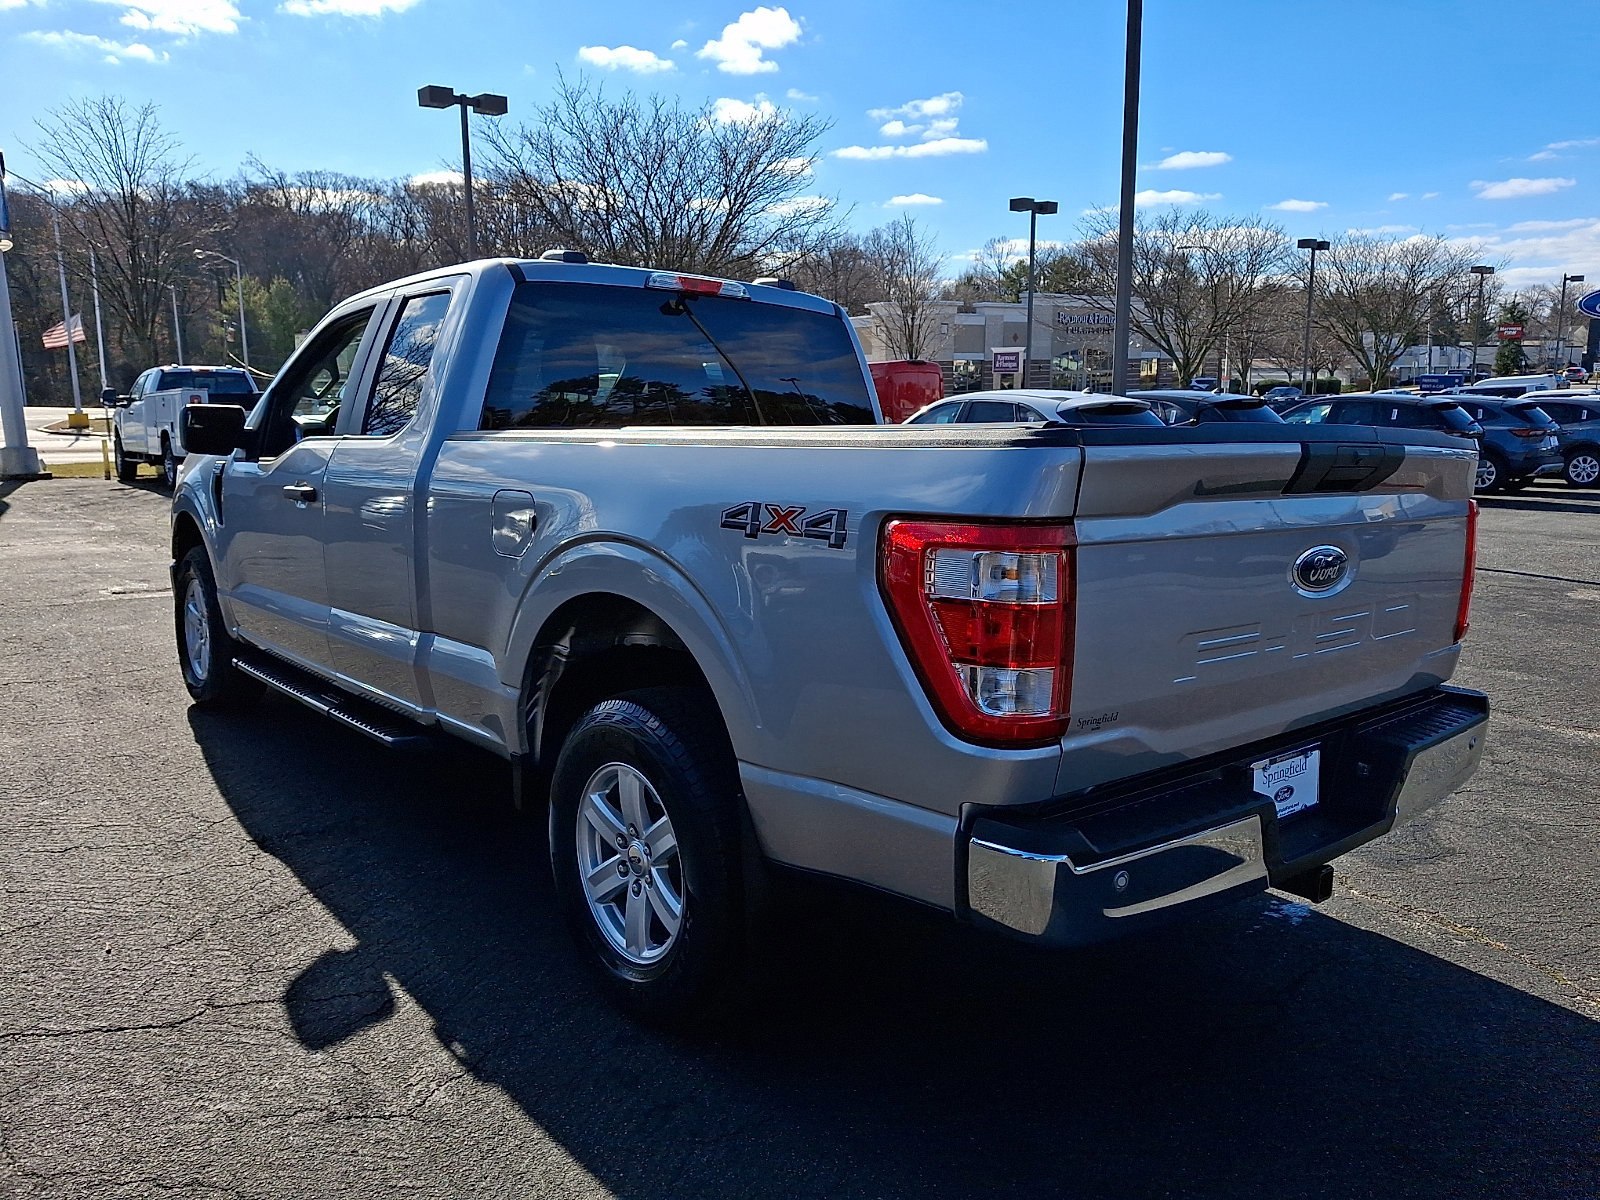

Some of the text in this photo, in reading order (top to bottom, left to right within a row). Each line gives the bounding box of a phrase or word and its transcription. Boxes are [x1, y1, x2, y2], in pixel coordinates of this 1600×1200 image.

[1058, 311, 1089, 325] Raymour
[1077, 711, 1119, 730] Springfield
[1262, 757, 1308, 788] Springfield
